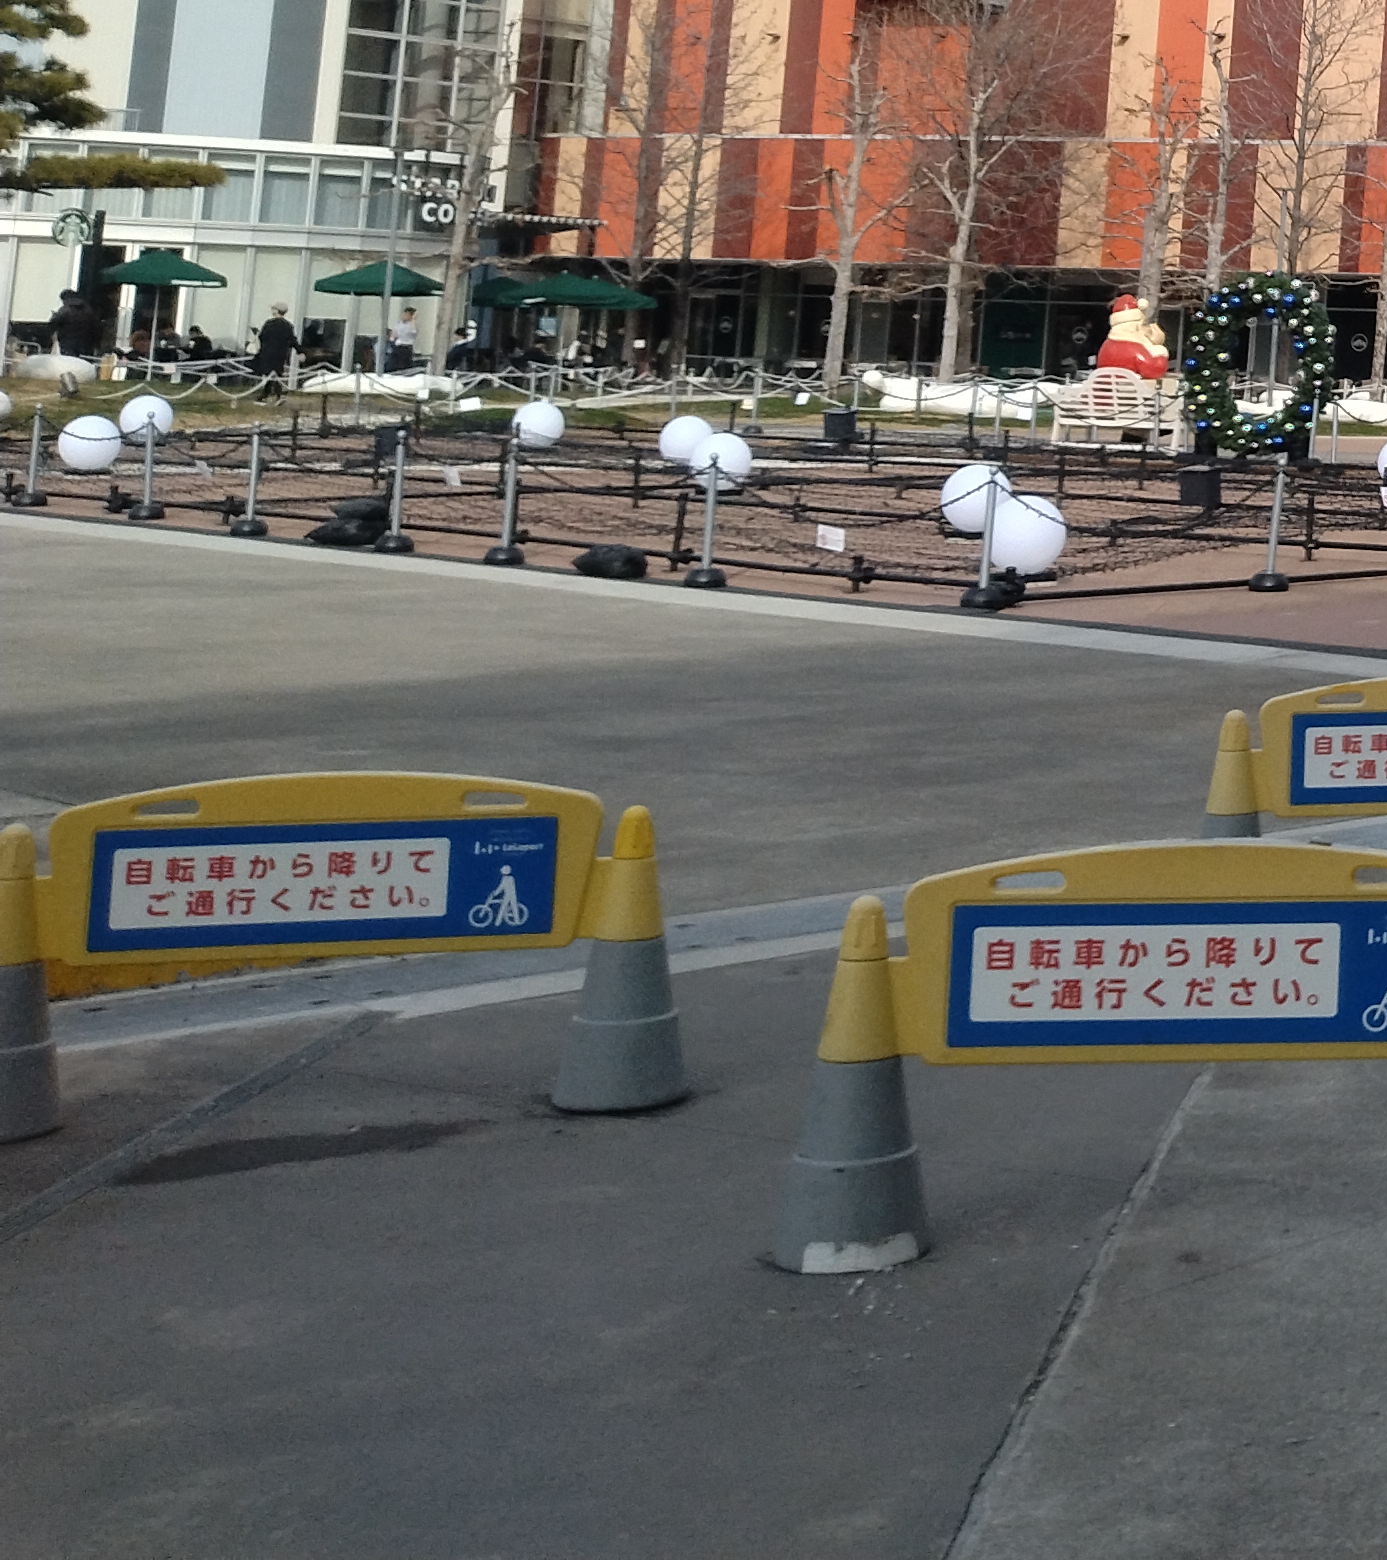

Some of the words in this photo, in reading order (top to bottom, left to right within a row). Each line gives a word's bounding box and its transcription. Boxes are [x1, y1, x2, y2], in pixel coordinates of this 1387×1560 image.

[126, 850, 434, 886] 自転車から降りて
[145, 885, 431, 919] ご通行ください。
[986, 937, 1323, 971] 自転車から降りて
[1008, 977, 1320, 1011] ご通行ください。
